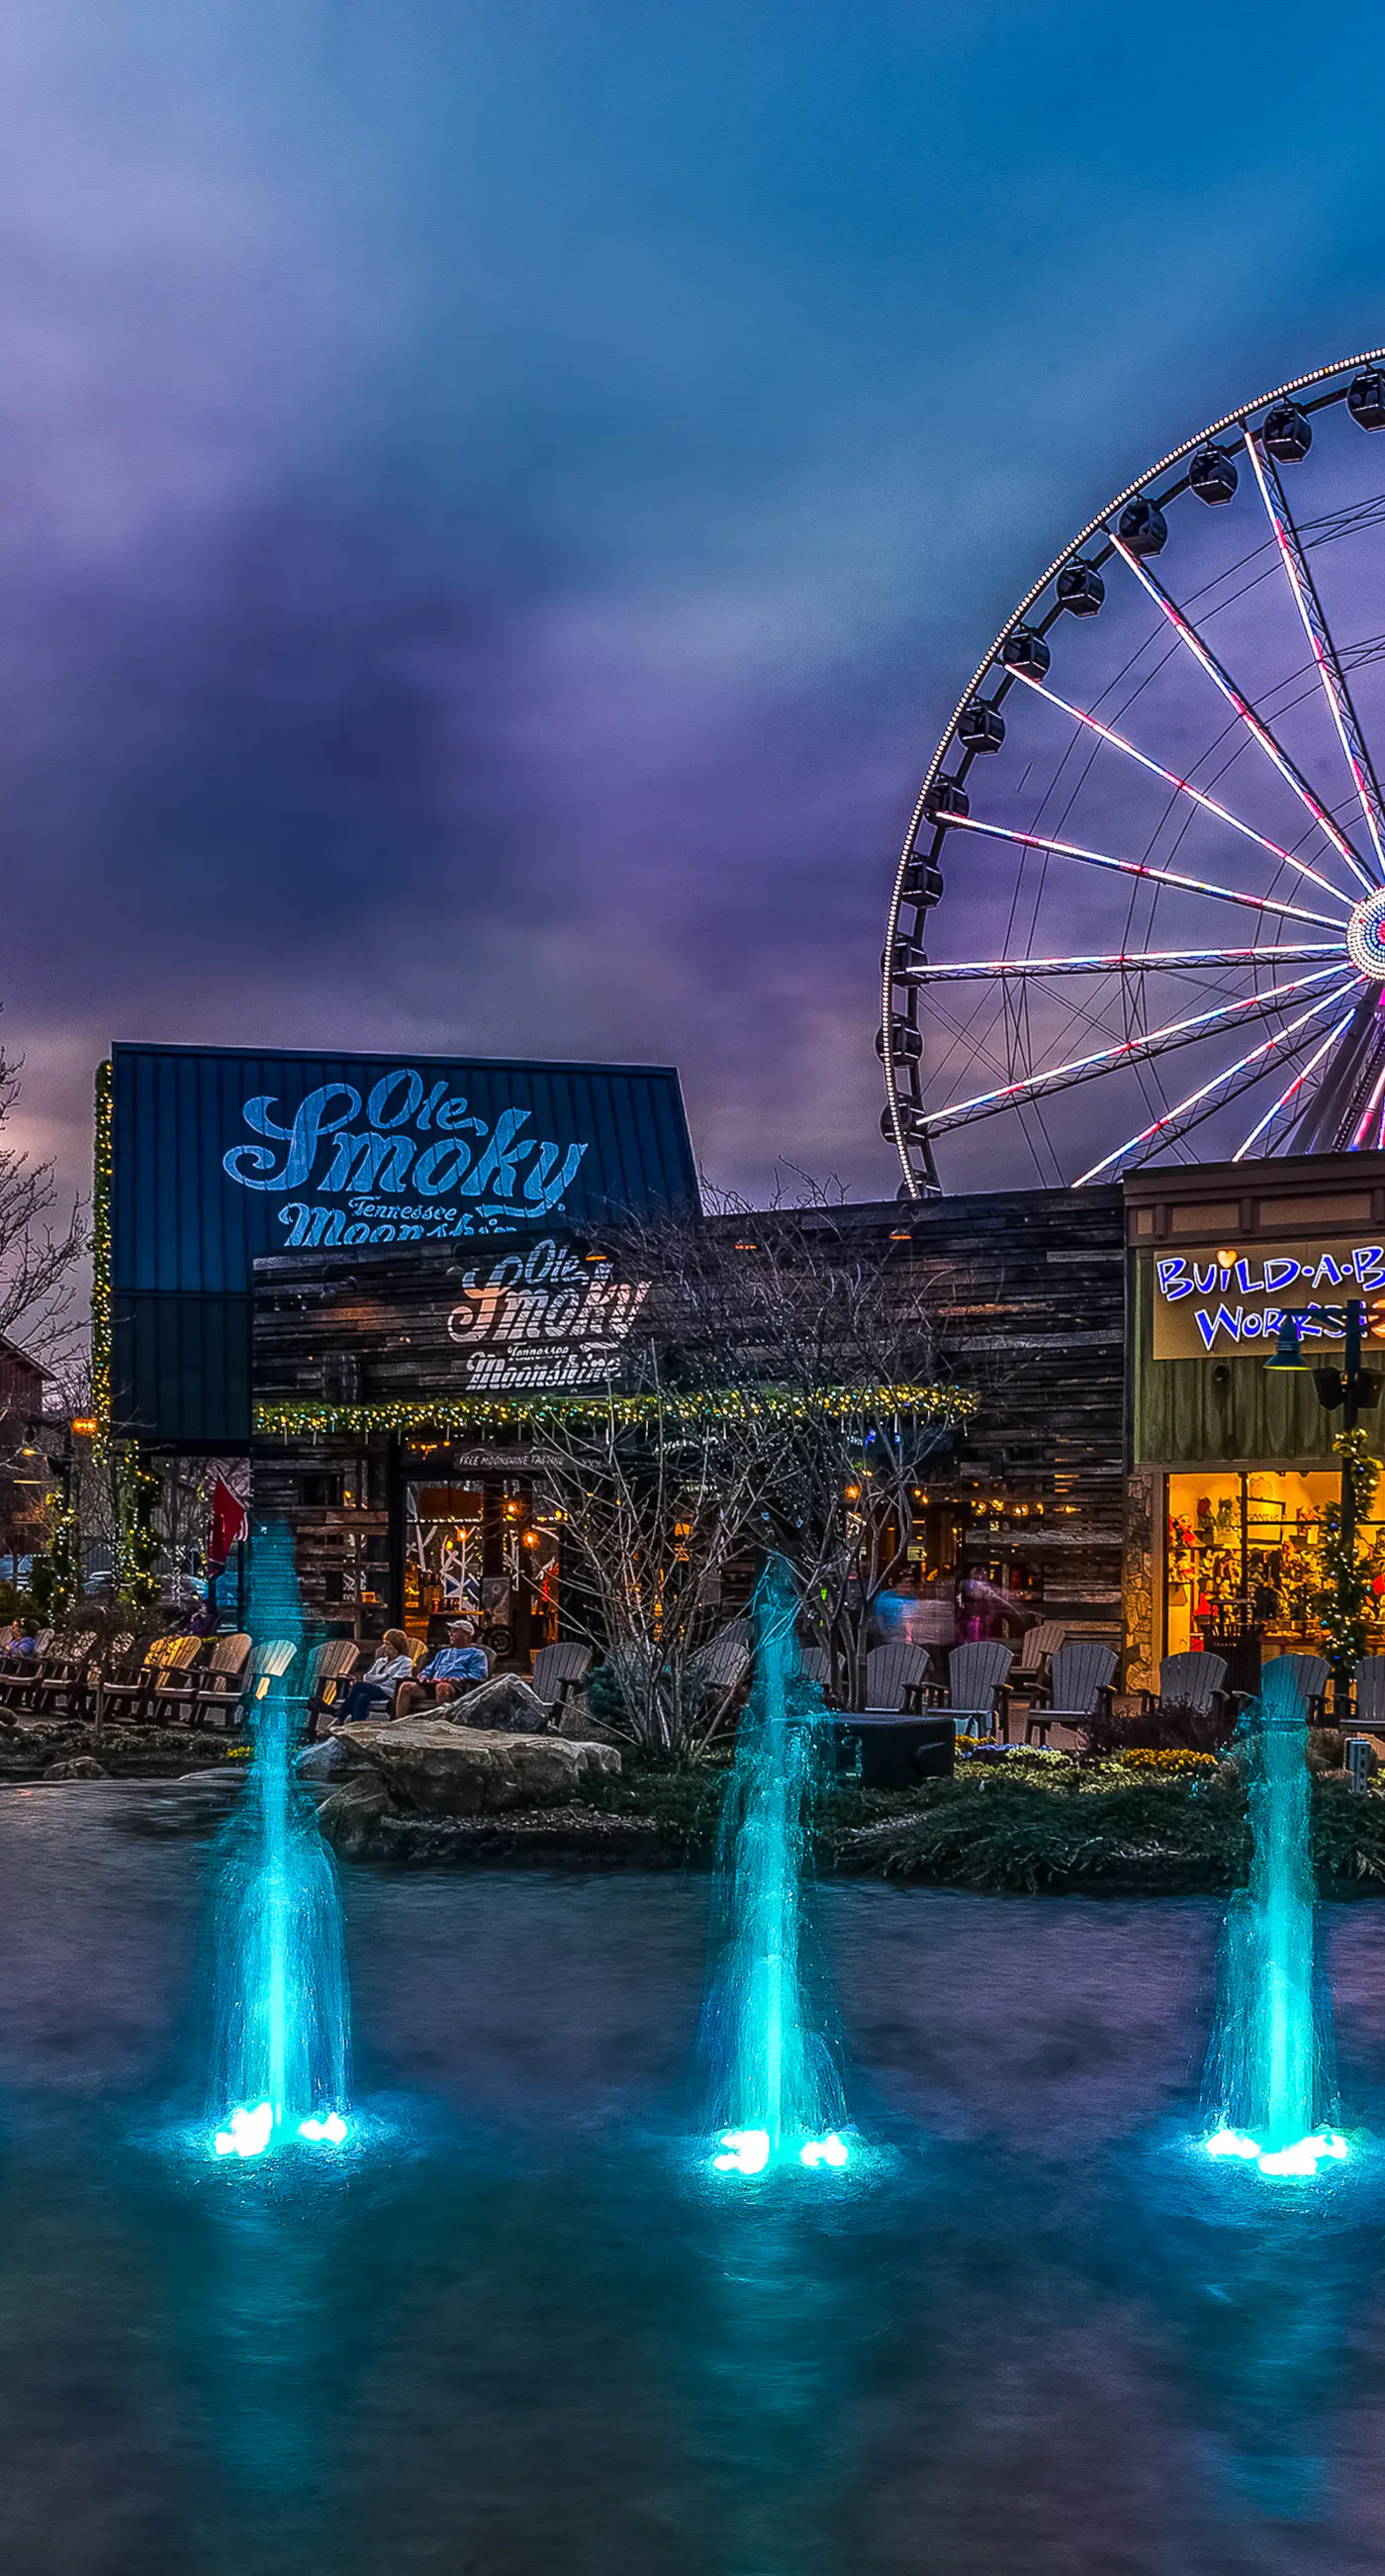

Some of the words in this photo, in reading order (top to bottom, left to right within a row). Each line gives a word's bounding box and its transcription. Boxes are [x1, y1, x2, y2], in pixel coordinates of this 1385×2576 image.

[367, 1068, 489, 1136] Ole
[222, 1082, 590, 1219] Smoky
[348, 1195, 458, 1221] Tennessee
[524, 1239, 591, 1286] Ole
[446, 1255, 653, 1353] Smoky
[458, 1455, 480, 1467] FREE
[481, 1455, 529, 1467] MOONSHINE
